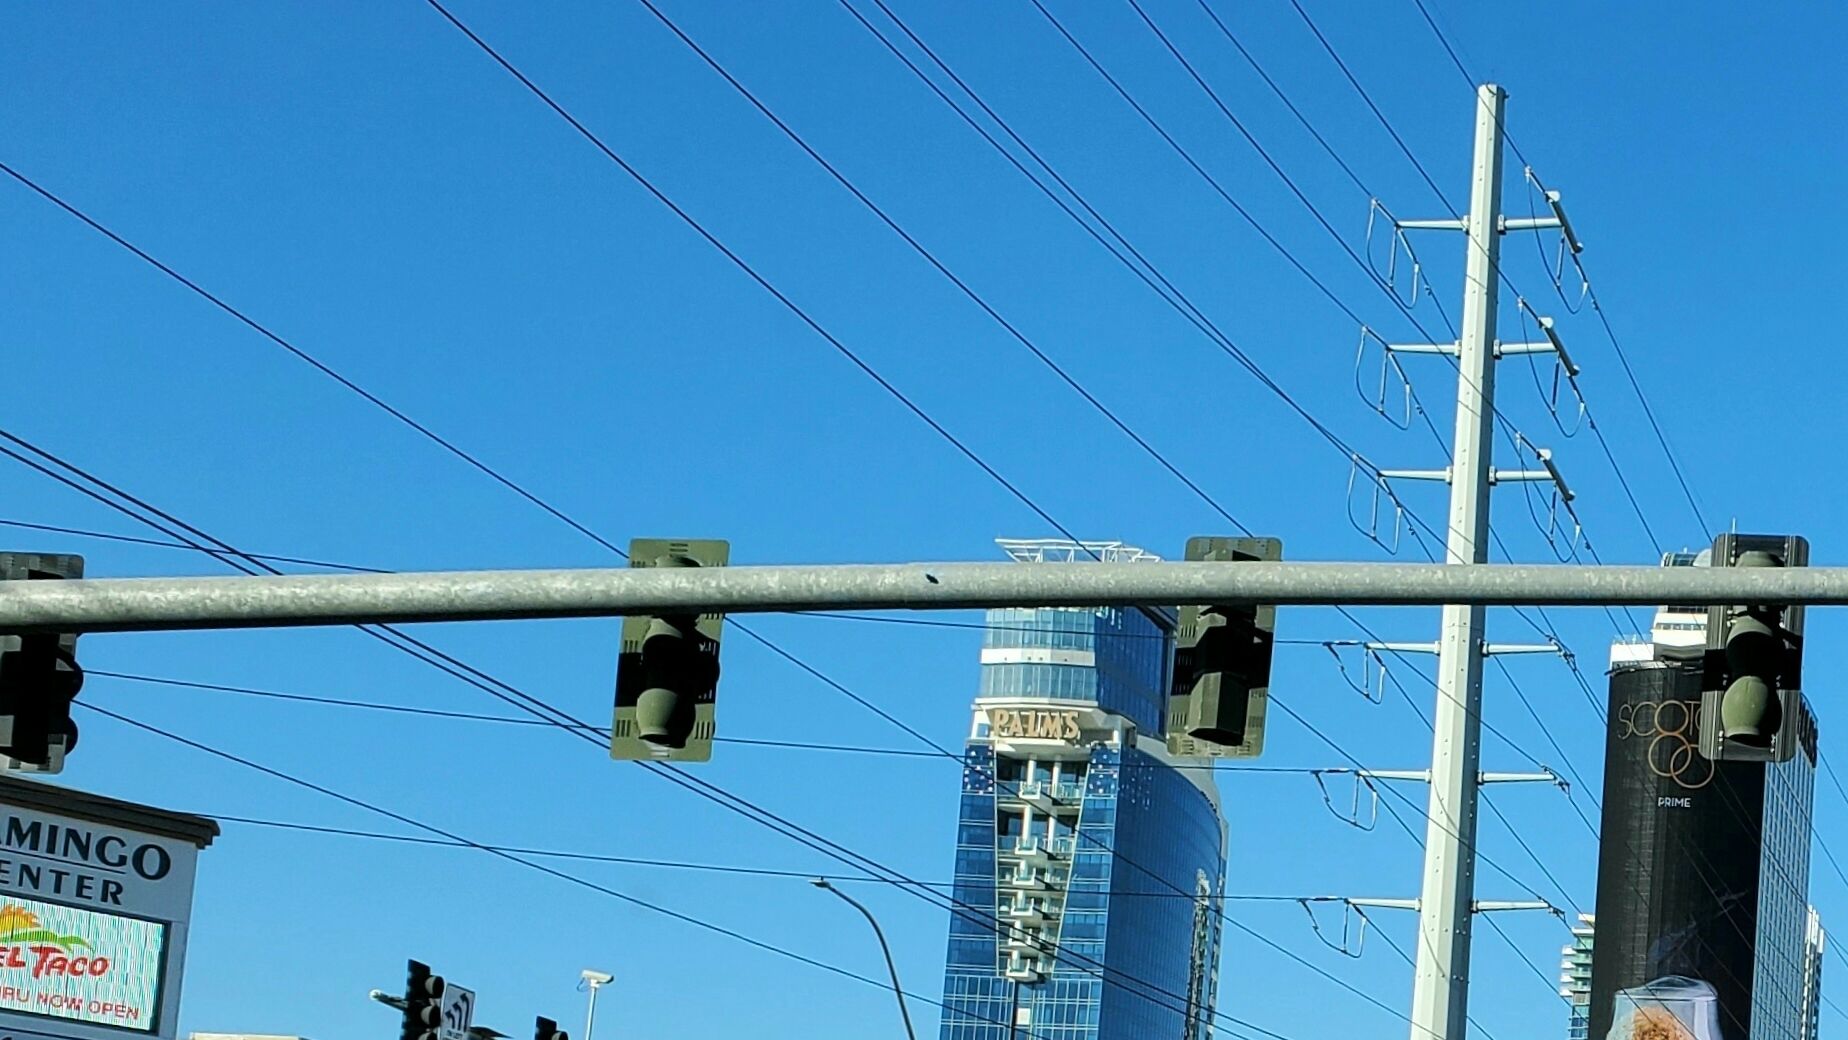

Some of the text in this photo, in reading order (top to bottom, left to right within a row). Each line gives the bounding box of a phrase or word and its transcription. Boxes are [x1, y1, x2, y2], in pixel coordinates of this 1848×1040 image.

[993, 709, 1079, 740] PALMS
[1618, 700, 1701, 740] SCOT
[1657, 797, 1692, 808] PRIME
[0, 816, 171, 881] MINGO
[89, 1000, 139, 1020] OPEN
